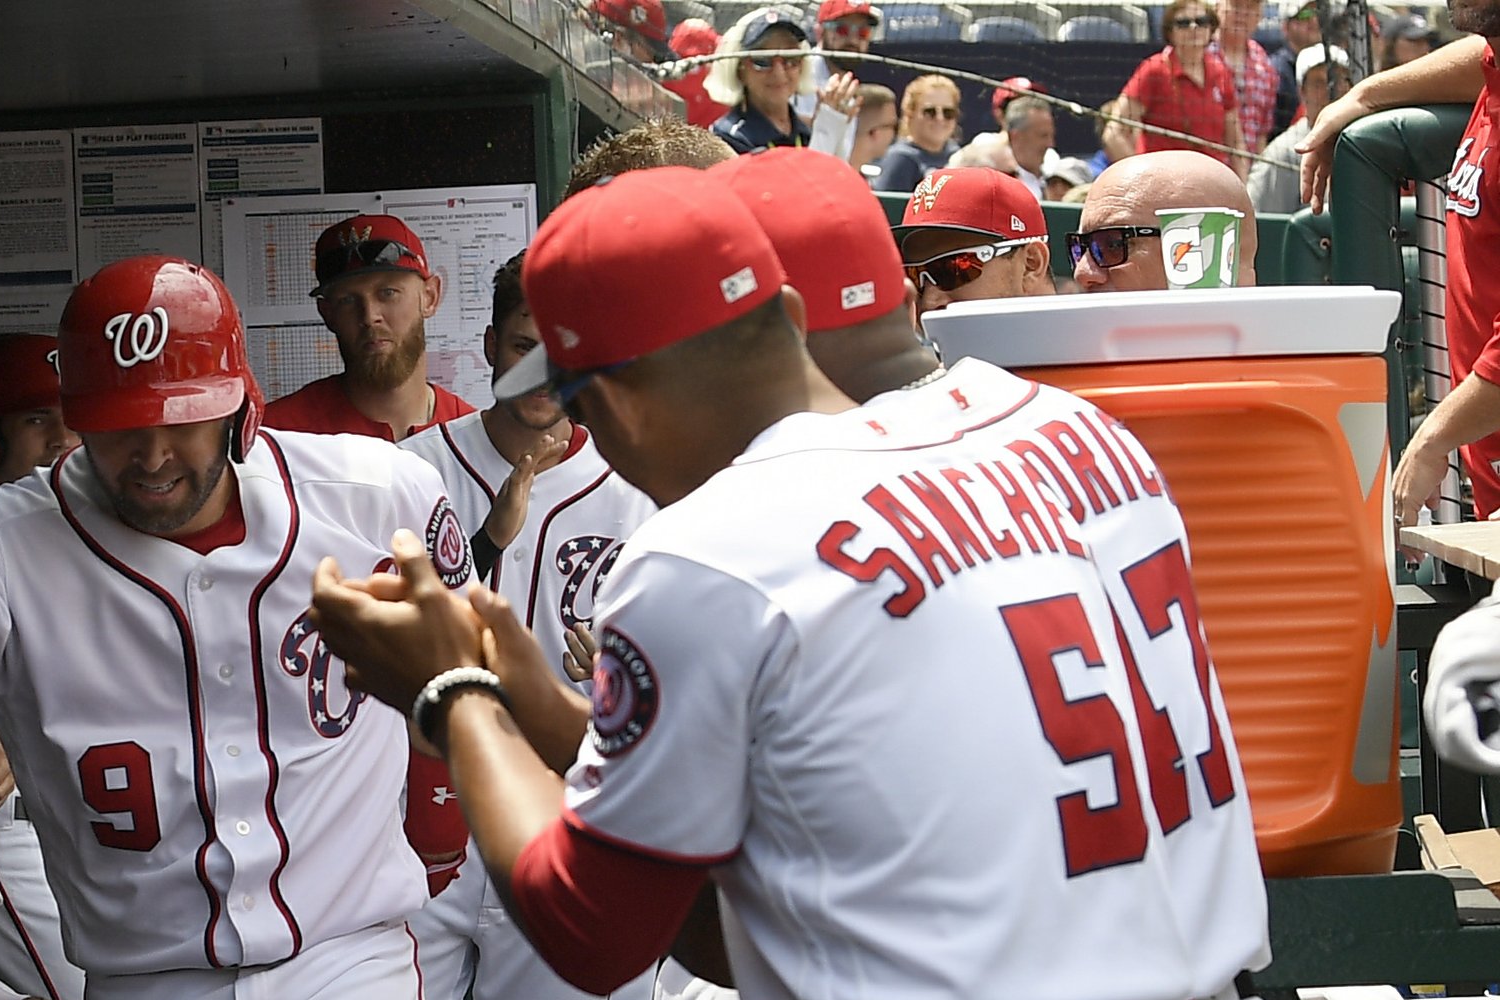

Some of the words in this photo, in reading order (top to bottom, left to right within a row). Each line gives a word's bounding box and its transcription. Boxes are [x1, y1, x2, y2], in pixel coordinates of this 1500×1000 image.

[126, 134, 142, 142] PLAY
[143, 132, 187, 141] PROCEDURES
[1162, 226, 1204, 286] G
[103, 305, 170, 369] W
[997, 592, 1150, 880] 5
[76, 740, 162, 853] 9
